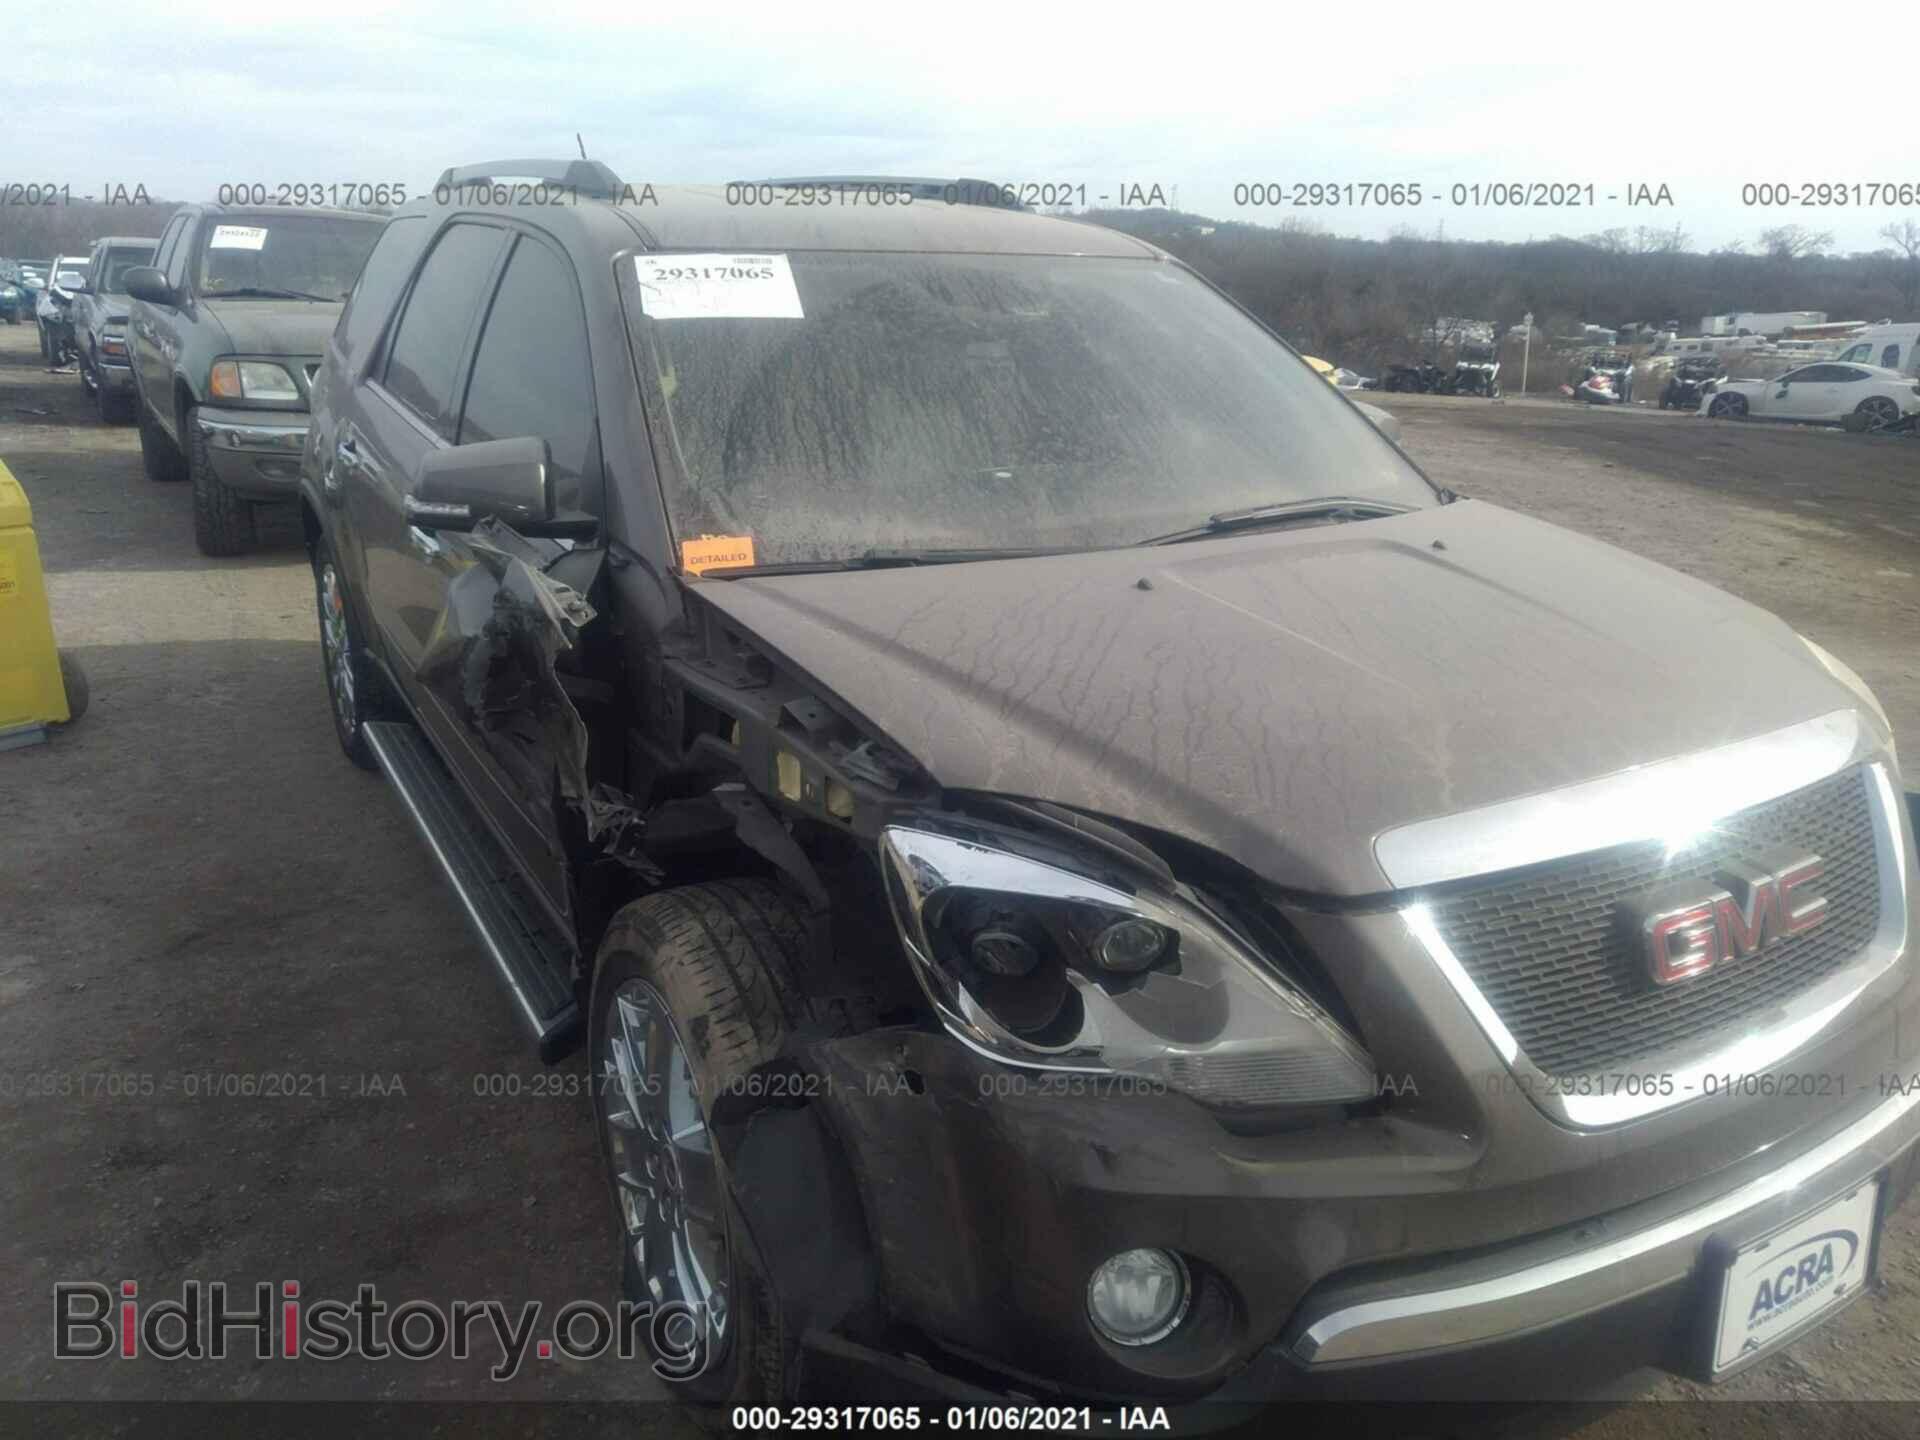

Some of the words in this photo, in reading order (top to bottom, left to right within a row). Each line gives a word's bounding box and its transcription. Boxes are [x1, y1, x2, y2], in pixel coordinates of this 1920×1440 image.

[653, 266, 775, 281] 29317065
[689, 552, 747, 565] DETAILED
[1645, 855, 1827, 985] GMC
[1747, 1242, 1834, 1321] ACRA
